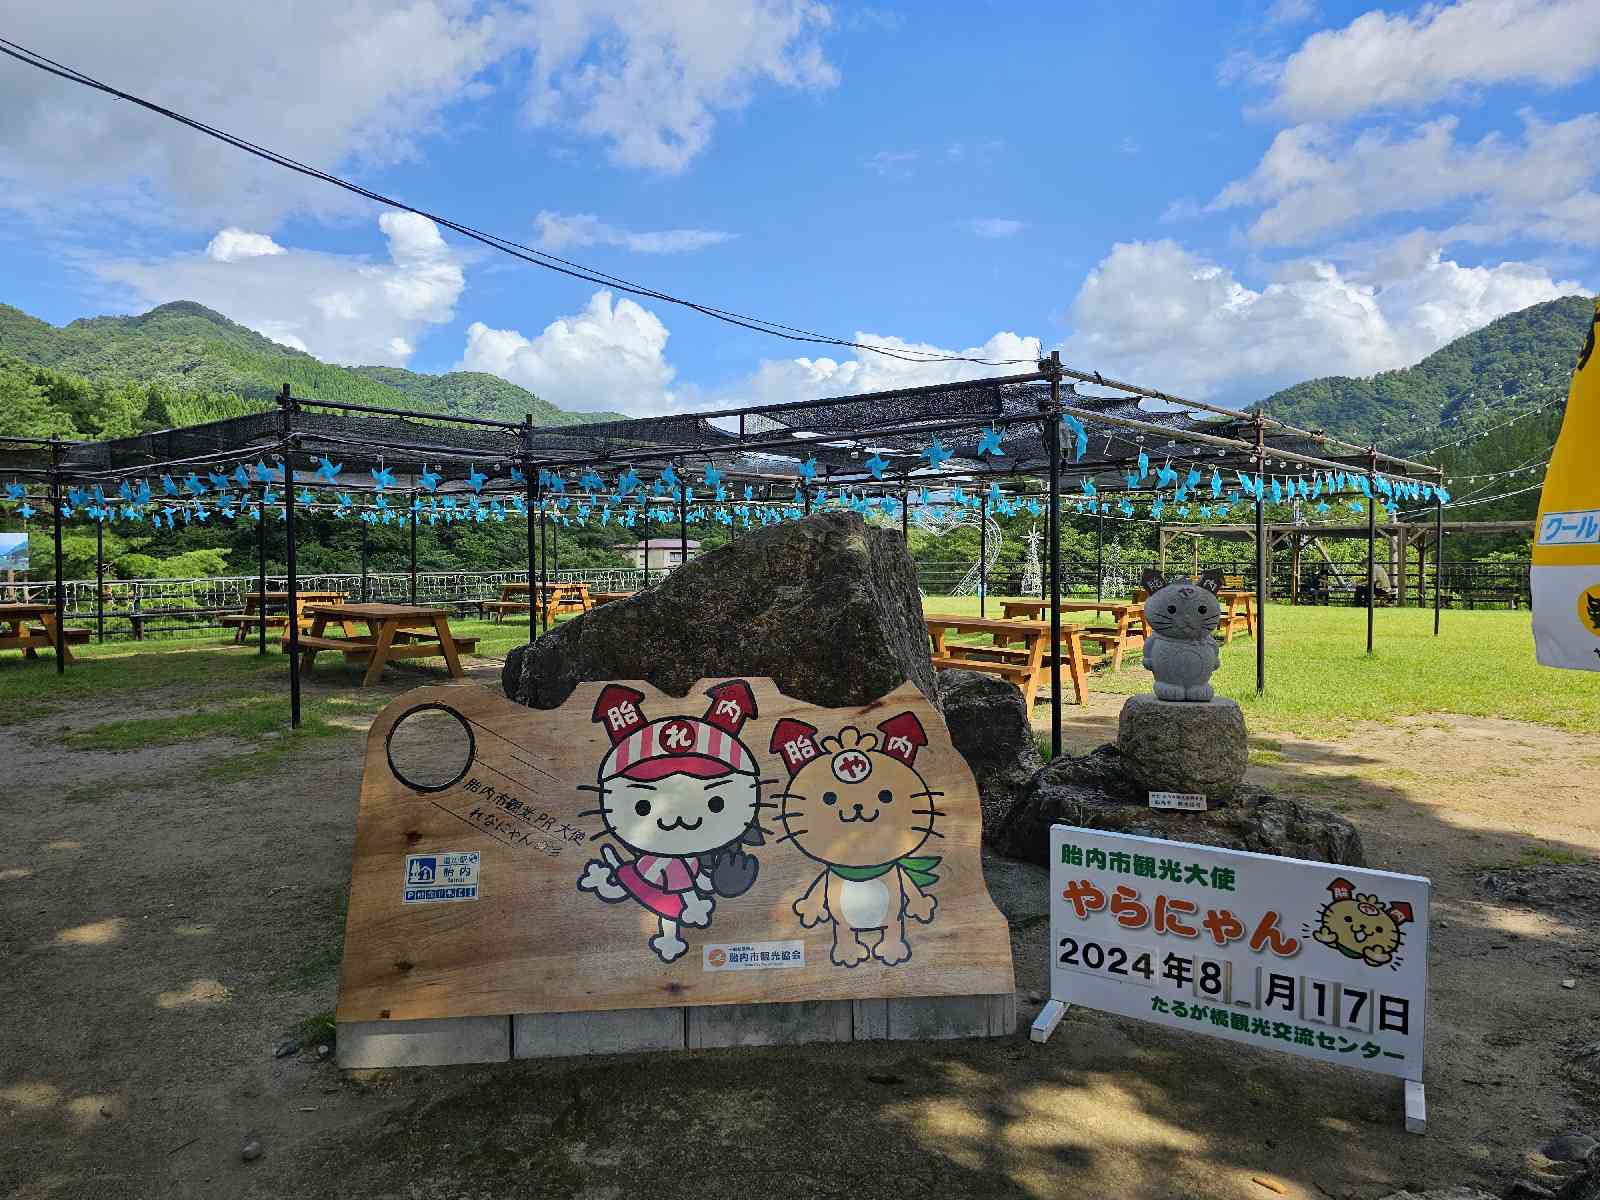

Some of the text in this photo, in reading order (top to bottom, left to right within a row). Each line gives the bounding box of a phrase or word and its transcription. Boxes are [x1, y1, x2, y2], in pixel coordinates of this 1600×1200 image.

[607, 701, 638, 731] 胎
[664, 723, 693, 748] れ
[784, 736, 817, 764] 胎
[839, 755, 867, 778] や
[1061, 844, 1236, 891] 胎内市観光大使
[1062, 879, 1302, 957] やらにゃん
[1150, 995, 1405, 1061] たるが橋観光交流センター
